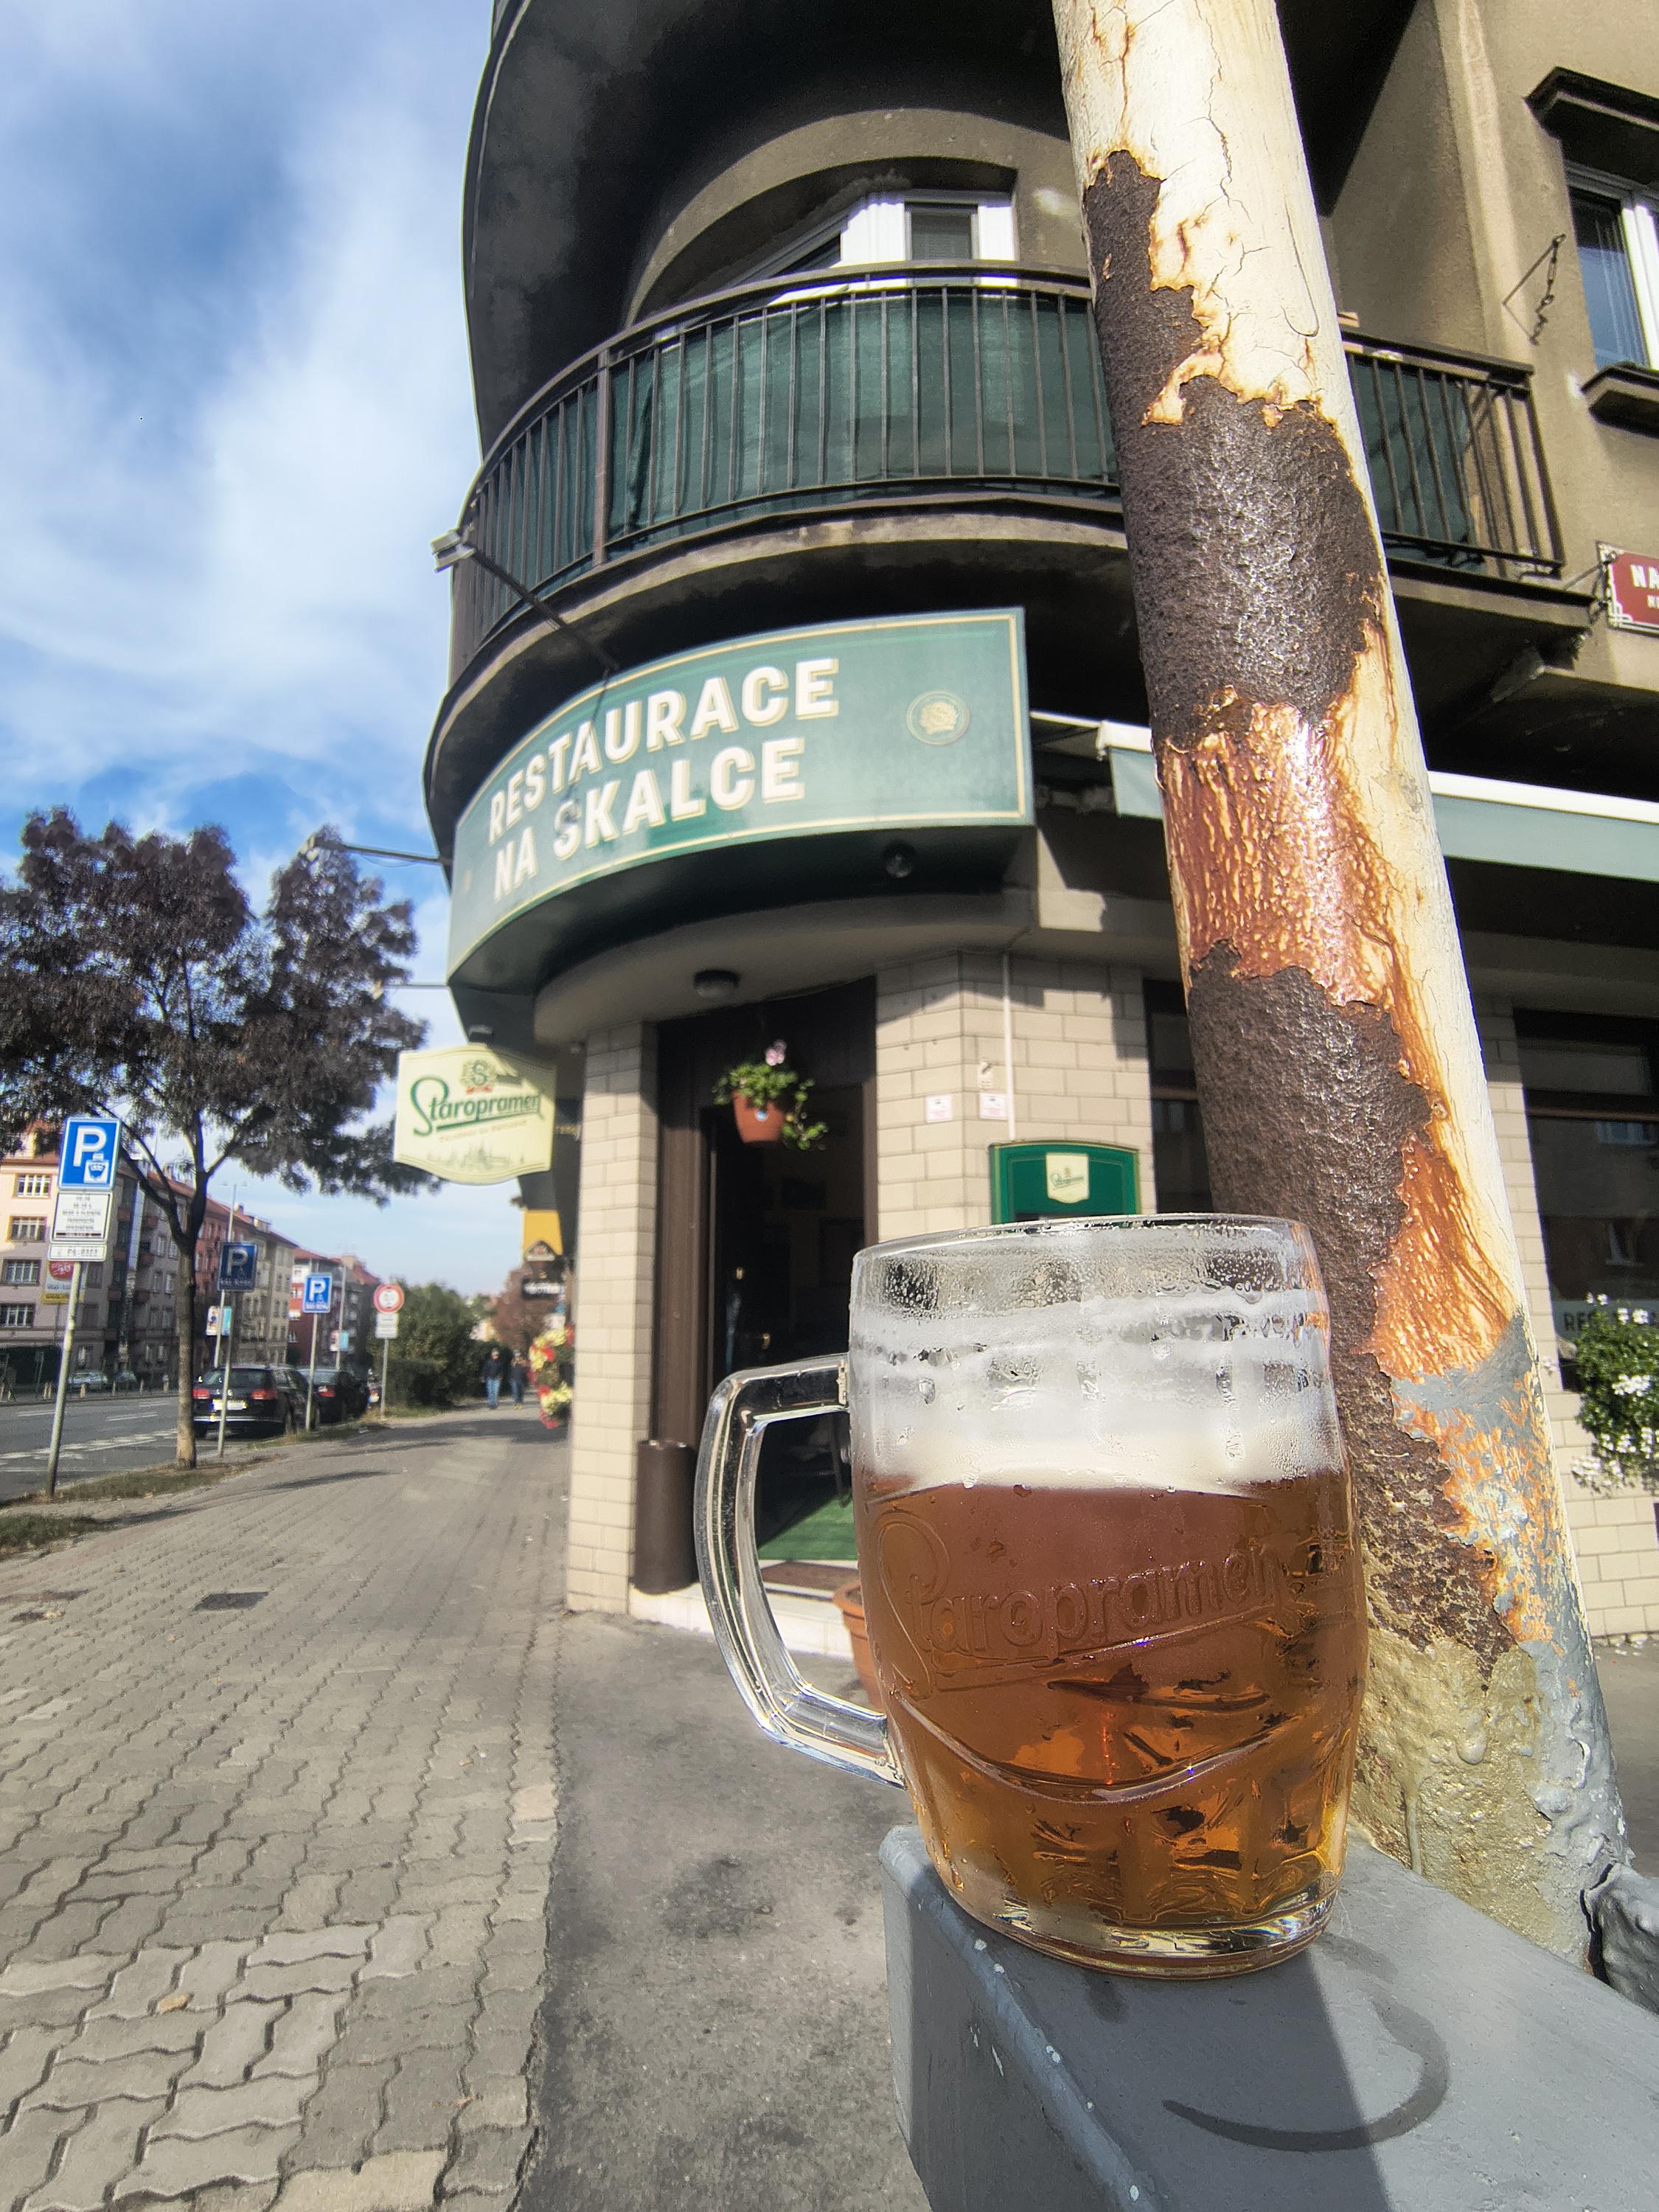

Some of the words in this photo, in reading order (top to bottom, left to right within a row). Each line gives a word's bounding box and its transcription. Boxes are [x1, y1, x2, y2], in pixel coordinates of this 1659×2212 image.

[489, 658, 839, 846] RESTAURACE
[494, 826, 538, 902] NA
[553, 737, 805, 861] SKALCE
[410, 1074, 544, 1137] Staropramen
[73, 1126, 108, 1167] P
[227, 1247, 248, 1276] P
[309, 1279, 326, 1301] P
